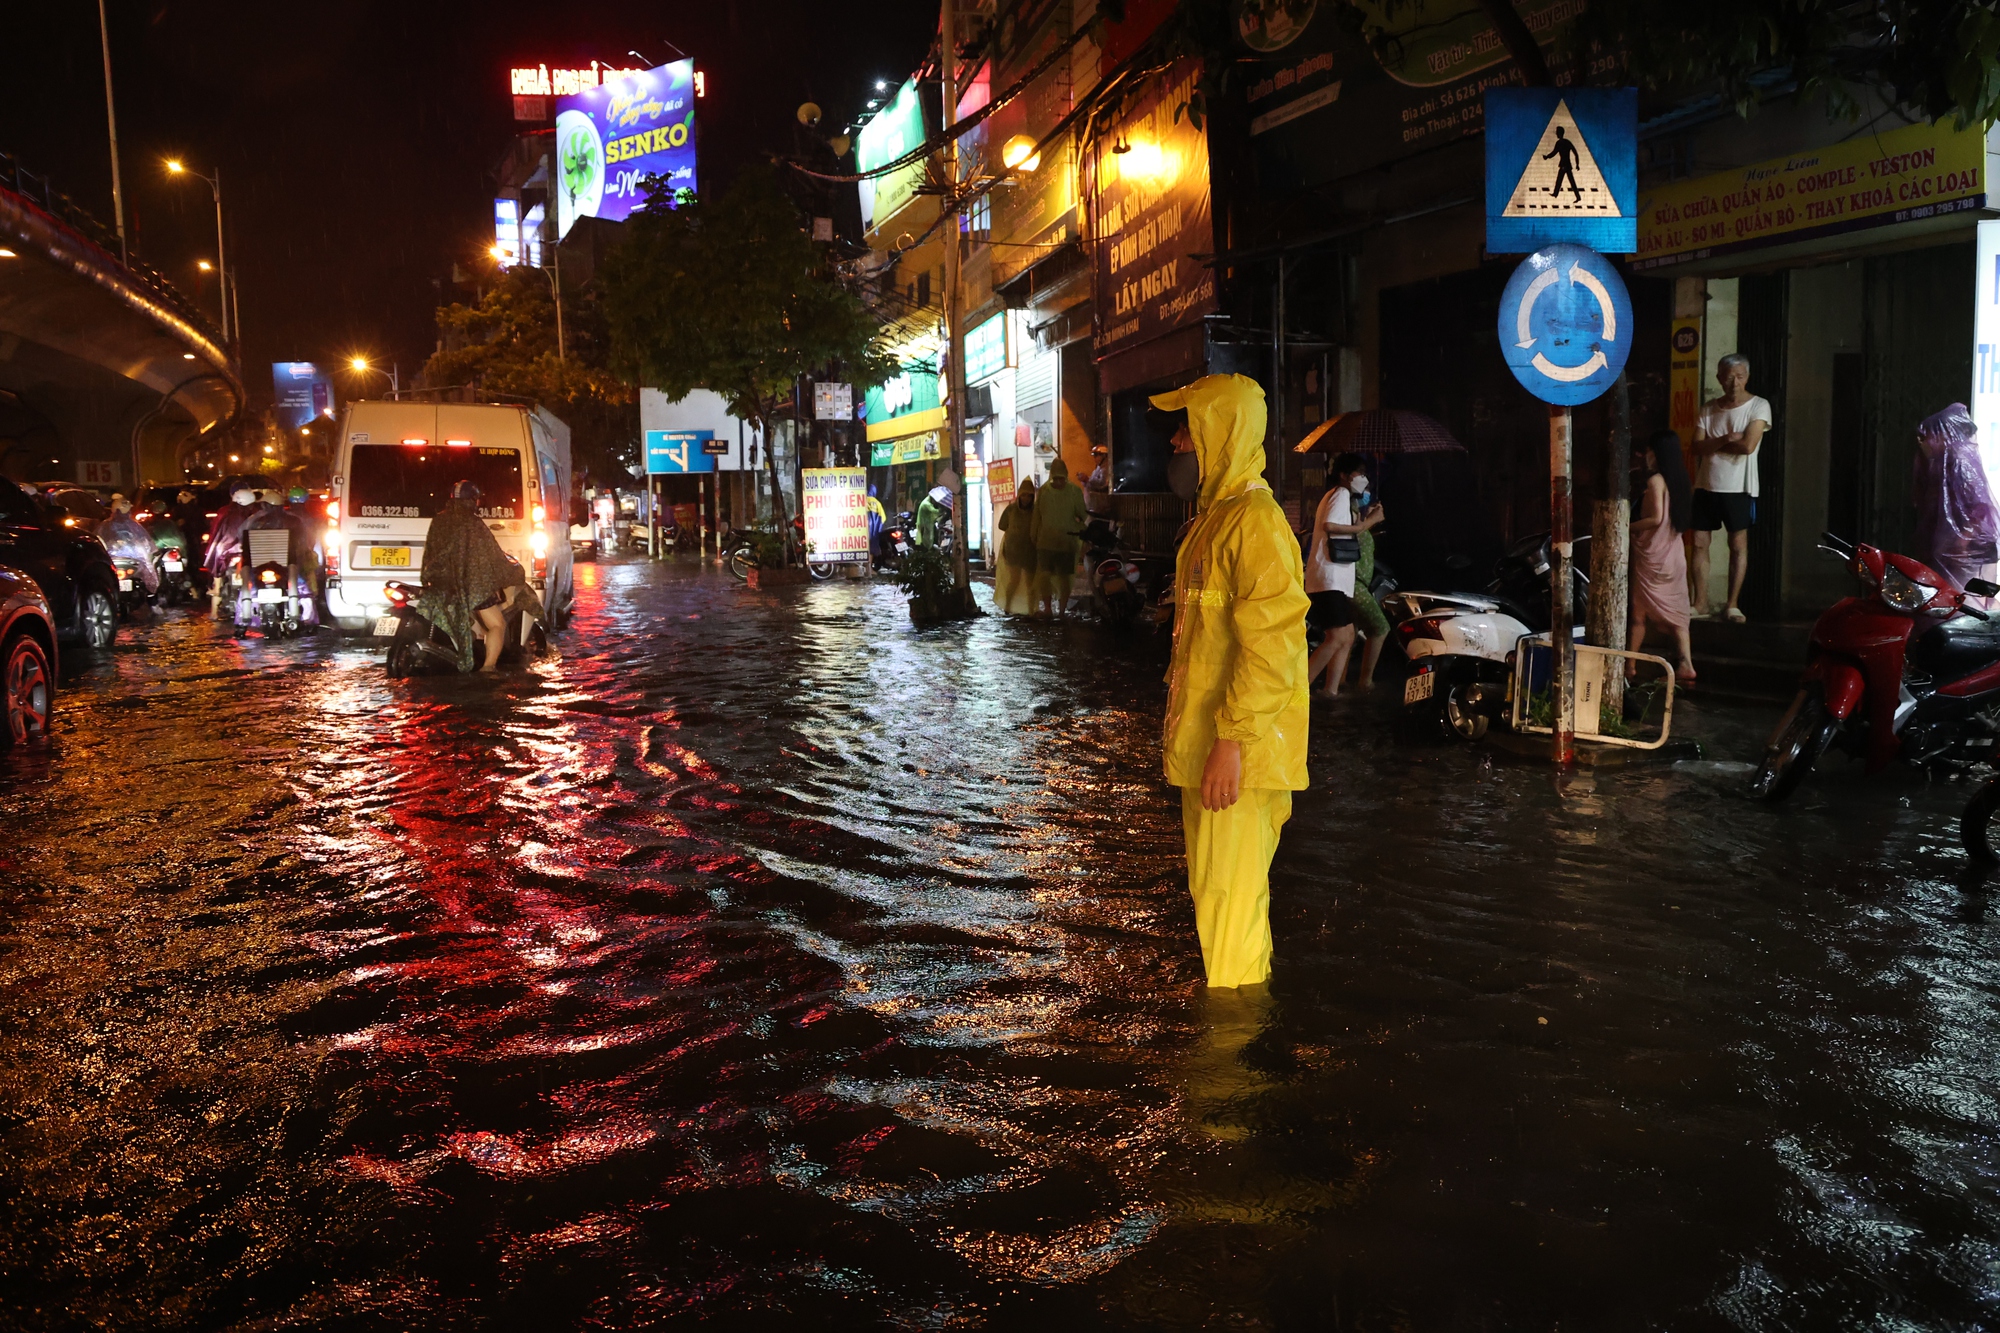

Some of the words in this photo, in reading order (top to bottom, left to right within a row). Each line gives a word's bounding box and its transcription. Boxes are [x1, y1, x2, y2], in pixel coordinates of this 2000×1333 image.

[1296, 52, 1334, 84] phong
[1428, 54, 1449, 74] Vật
[1402, 108, 1418, 122] Địa
[1441, 90, 1454, 108] Số
[1456, 84, 1476, 102] 626
[1403, 126, 1425, 142] Điện
[1462, 103, 1483, 121] 024
[605, 122, 688, 164] SENKO
[1655, 202, 1679, 225] SỬA
[1683, 194, 1718, 220] CHỮA
[1722, 183, 1761, 213] QUẦN
[1765, 181, 1785, 202] ÁO
[1797, 166, 1856, 194] COMPLE
[1869, 148, 1935, 178] VESTON
[1636, 228, 1662, 253] UẦN
[1711, 222, 1725, 239] MI
[1735, 208, 1772, 237] QUẦN
[1777, 203, 1794, 226] BÒ
[1806, 196, 1846, 221] THAY
[1850, 181, 1895, 212] KHOÁ
[1899, 176, 1931, 201] CÁC
[1937, 168, 1978, 194] LOẠI
[1911, 206, 1934, 219] 0903
[1936, 202, 1954, 214] 295
[1956, 198, 1975, 210] 798
[1110, 243, 1119, 275] ÉP
[1158, 201, 1182, 245] THOẠI
[1115, 277, 1138, 316] LẤY
[1141, 258, 1178, 303] NGAY
[1678, 334, 1694, 347] 626
[87, 463, 111, 482] H5
[805, 472, 818, 489] SỬA
[820, 473, 837, 488] CHỮA
[849, 471, 865, 487] KÍNH
[990, 477, 1014, 496] THẺ
[837, 491, 866, 511] KIỆN
[361, 505, 419, 517] 0366.322.966
[837, 514, 867, 532] THOẠI
[841, 532, 867, 550] HÃNG
[375, 557, 405, 565] 016.17
[382, 548, 398, 557] 29F
[843, 552, 855, 560] 522
[1406, 685, 1431, 703] 137.38
